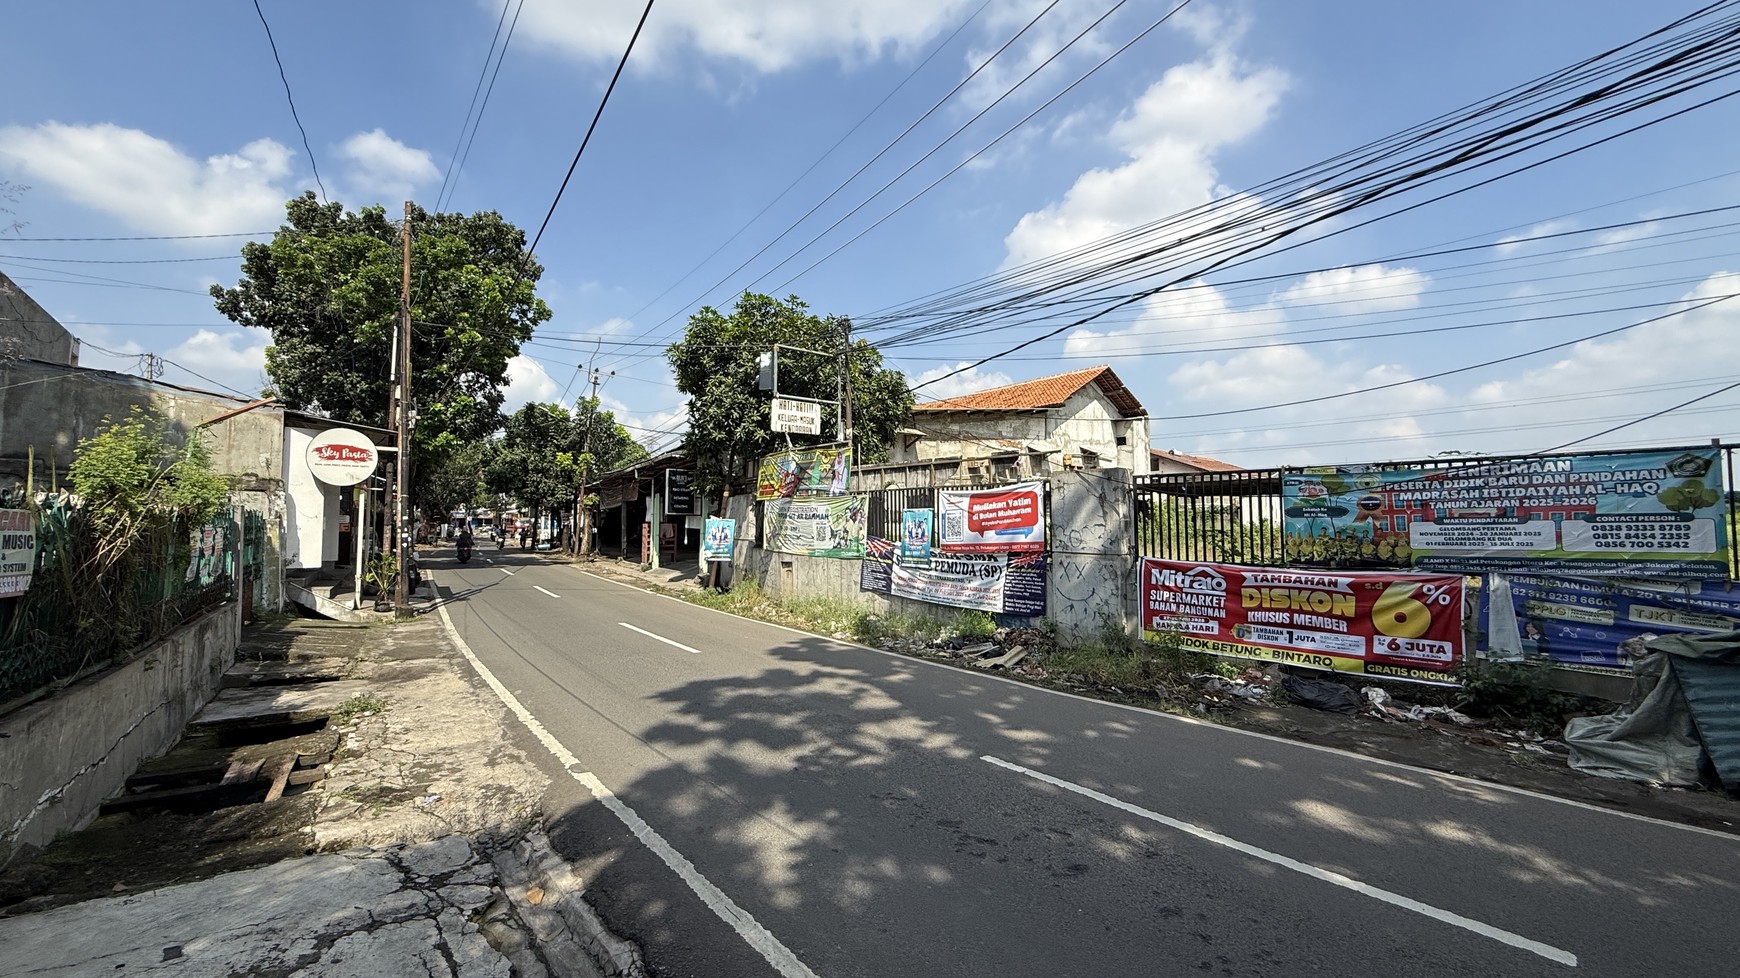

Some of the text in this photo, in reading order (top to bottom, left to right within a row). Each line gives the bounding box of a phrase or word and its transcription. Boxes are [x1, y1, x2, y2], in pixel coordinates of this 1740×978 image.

[320, 446, 369, 459] Sky Pasta
[1447, 460, 1571, 477] PENERIMAAN
[1385, 469, 1666, 491] PESERTA DIDIK BARU DAN PINDAHAN
[1400, 482, 1659, 501] MADRASAH IBTIDAIYAH AL-HAQ
[972, 498, 1032, 512] Muliakan Yatim
[1429, 497, 1597, 509] TAHUN AJARAN 2025-2026
[980, 511, 997, 520] Bulan
[998, 507, 1032, 518] Muharram
[1591, 524, 1692, 532] 0838 9333 8789
[2, 534, 34, 550] MUSIC
[1592, 532, 1691, 540] 0815 8454 2355
[2, 562, 26, 573] SYSTEM
[934, 560, 1002, 582] PEMUDA (SP)
[1151, 568, 1227, 591] Mitra10
[1251, 573, 1339, 589] TAMBAHAN
[1364, 582, 1384, 590] s.d
[1150, 590, 1226, 608] SUPERMARKET
[1548, 592, 1578, 602] 9238
[1636, 590, 1652, 599] 20
[1150, 601, 1226, 618] BAHAN BANGUNAN
[1240, 588, 1356, 618] DISKON
[1247, 611, 1348, 633] KHUSUS MEMBER
[1634, 608, 1676, 622] TJKT
[1192, 624, 1214, 633] HARI
[1252, 626, 1284, 636] TAMBAHAN
[1257, 634, 1279, 642] DISKON
[1286, 630, 1294, 644] 1
[1294, 634, 1317, 644] JUTA
[1386, 638, 1401, 652] 6
[1404, 642, 1447, 655] JUTA
[1212, 642, 1262, 657] BETUNG
[1272, 650, 1334, 668] BINTARO
[1367, 664, 1408, 676] GRATIS
